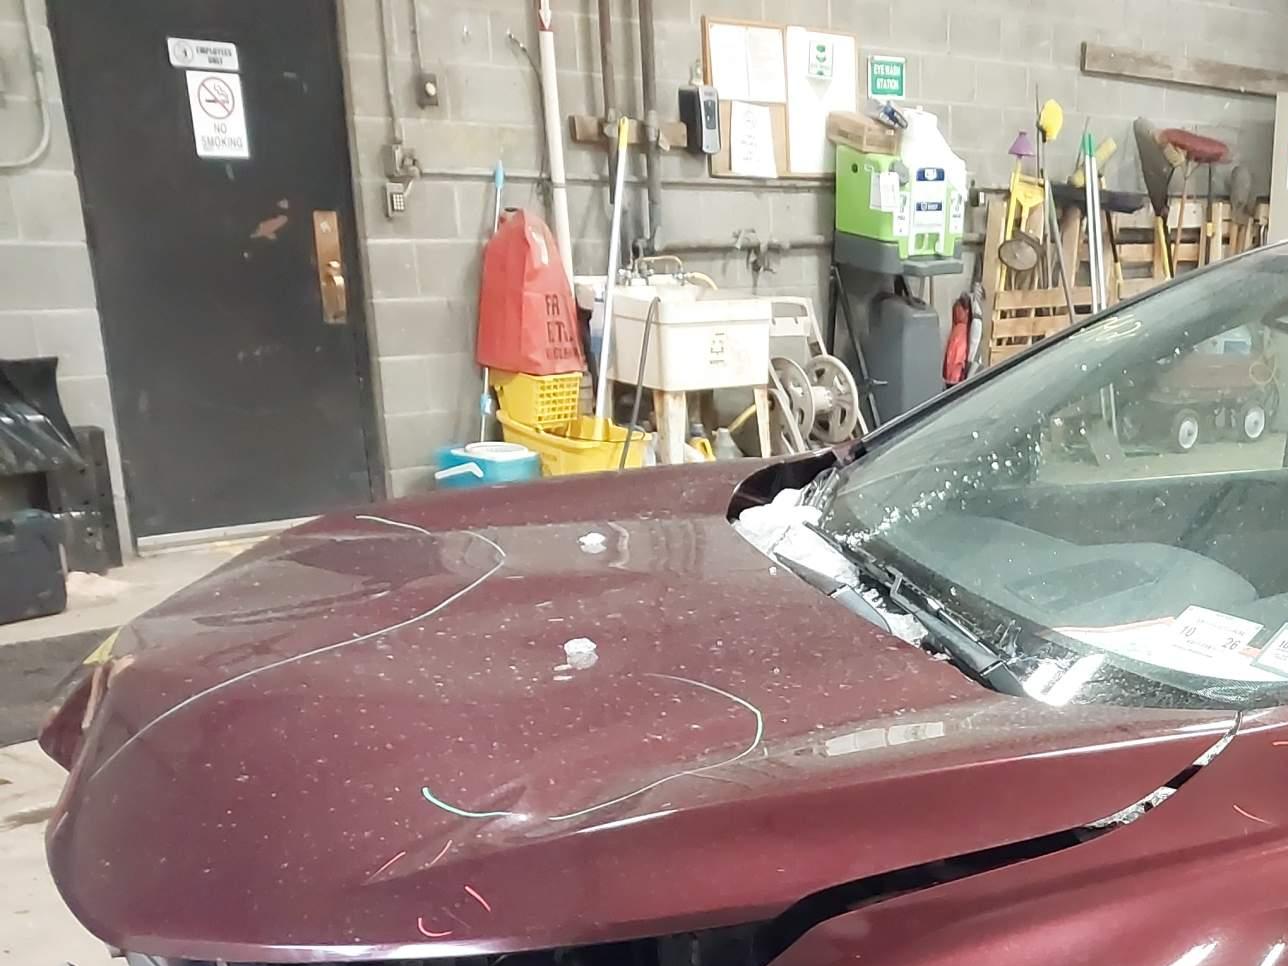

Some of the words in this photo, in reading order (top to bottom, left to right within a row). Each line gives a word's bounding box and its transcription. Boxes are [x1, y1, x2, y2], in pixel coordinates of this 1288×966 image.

[195, 46, 232, 57] EMPLOYEES
[873, 63, 885, 75] EYE
[885, 63, 901, 76] WASH
[876, 77, 899, 90] STATION
[213, 123, 228, 134] NO
[201, 136, 243, 149] SMOKING
[1221, 637, 1241, 650] 26
